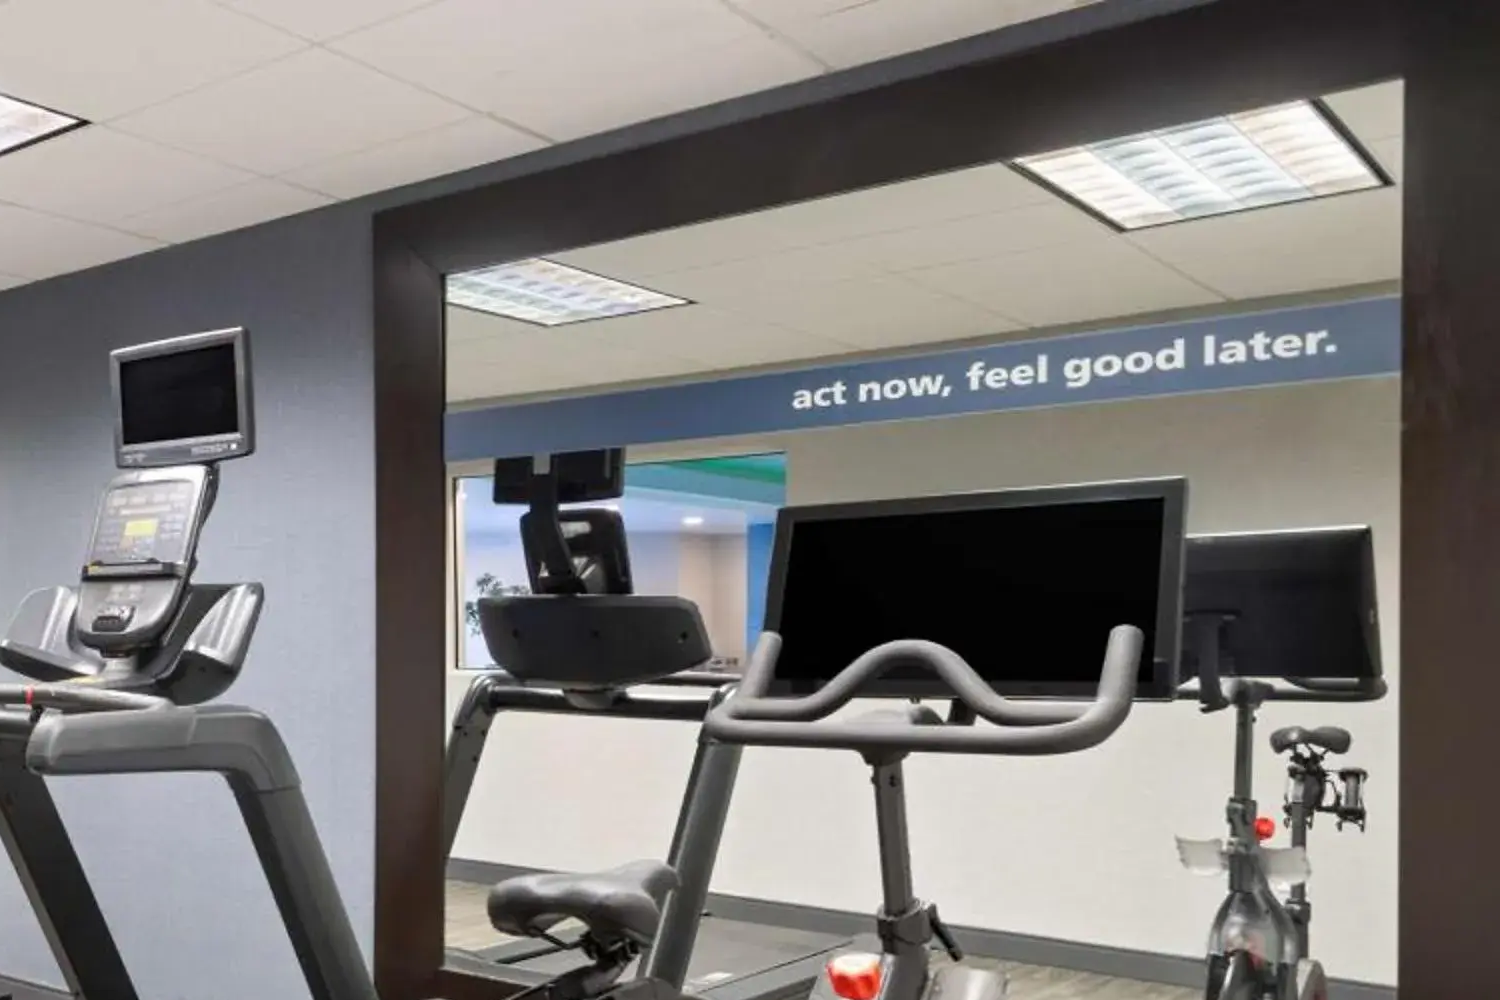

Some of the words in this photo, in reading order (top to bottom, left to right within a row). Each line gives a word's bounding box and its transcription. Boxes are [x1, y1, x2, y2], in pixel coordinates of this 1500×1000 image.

[792, 380, 847, 410] act
[858, 374, 952, 403] now,
[966, 354, 1049, 391] feel
[1063, 337, 1186, 388] good
[1203, 329, 1338, 366] later.
